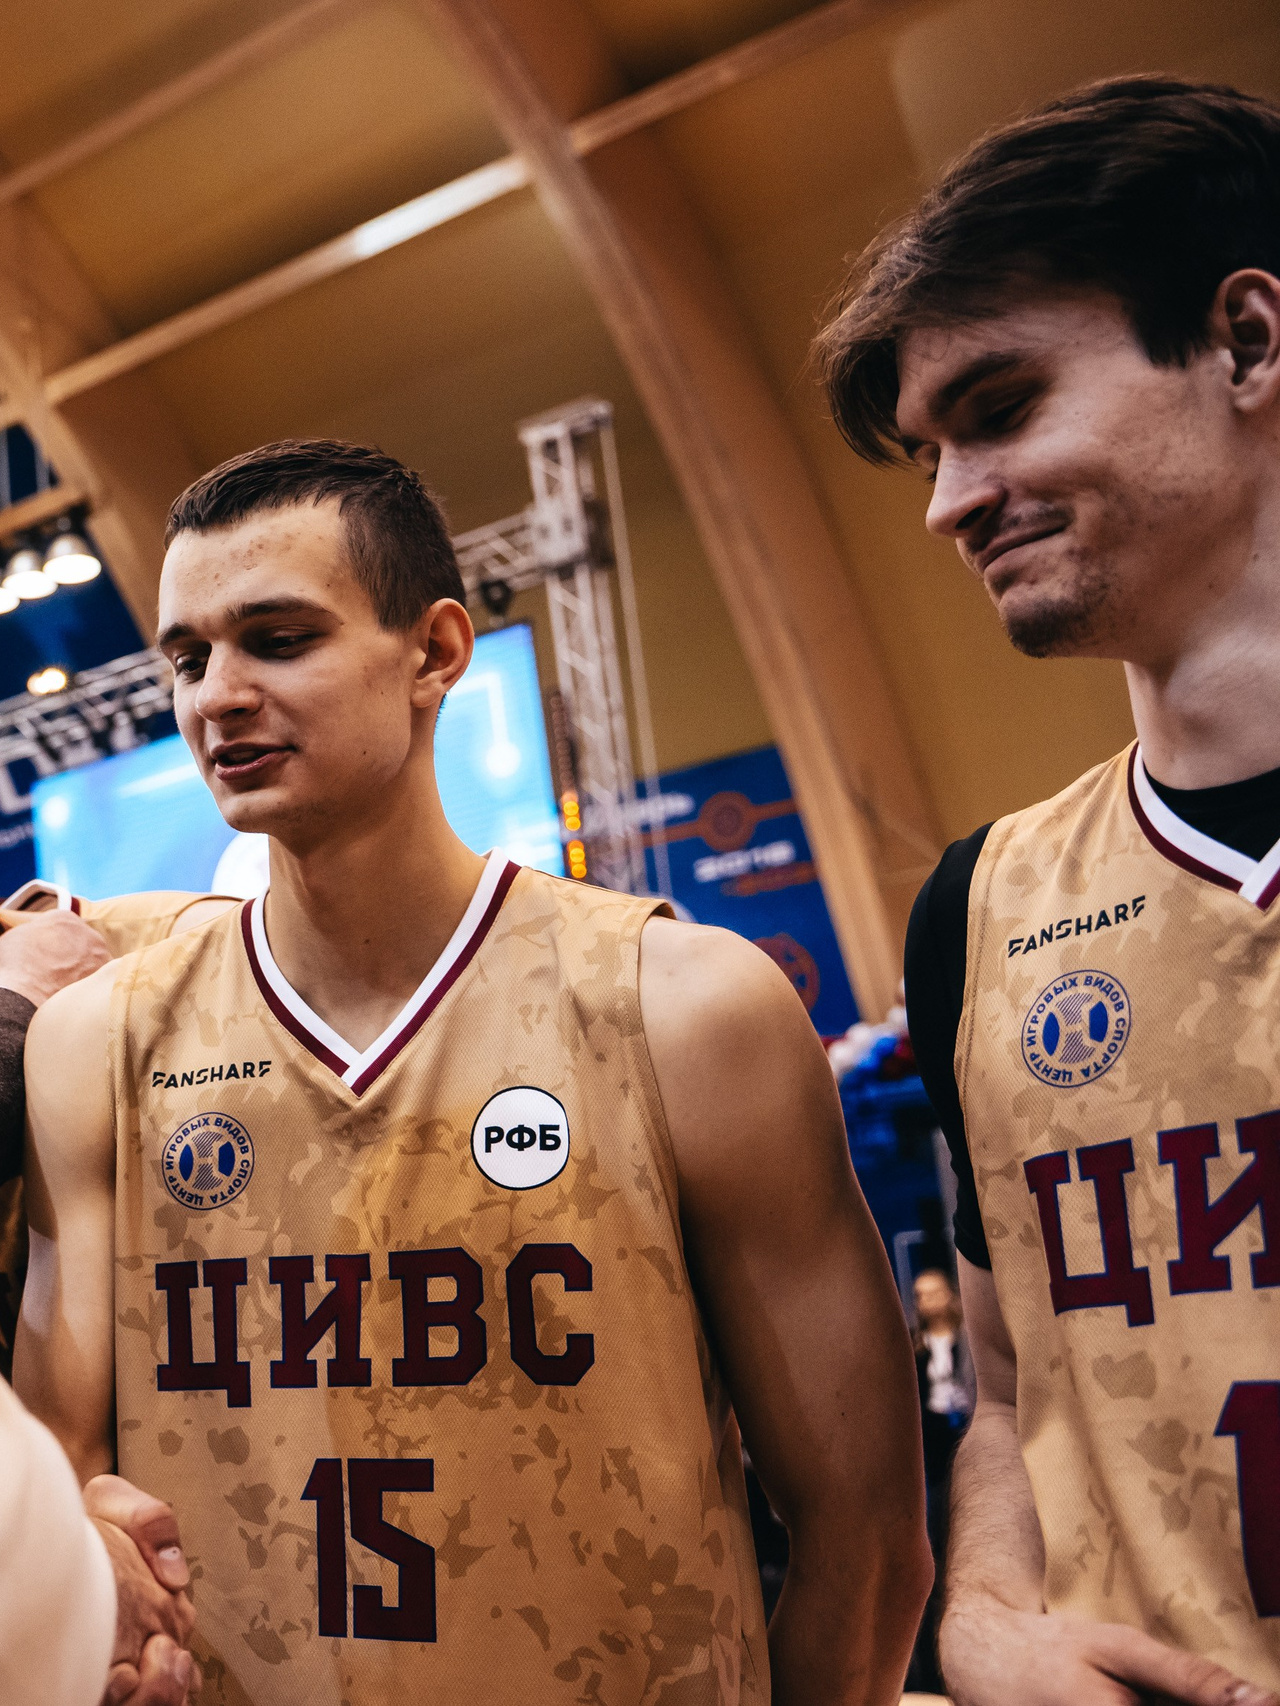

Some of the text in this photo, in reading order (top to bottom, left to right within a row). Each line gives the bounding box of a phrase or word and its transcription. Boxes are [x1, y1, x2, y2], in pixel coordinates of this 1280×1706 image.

[1026, 975, 1127, 1083] ЦЕНТР ИГРОВЫХ ВИДОВ СПОРТА
[165, 1116, 251, 1206] ЦЕНТР ИГРОВЫХ ВИДОВ СПОРТА
[484, 1123, 562, 1154] РФБ
[155, 1243, 595, 1408] ЦИВС
[300, 1457, 438, 1644] 15
